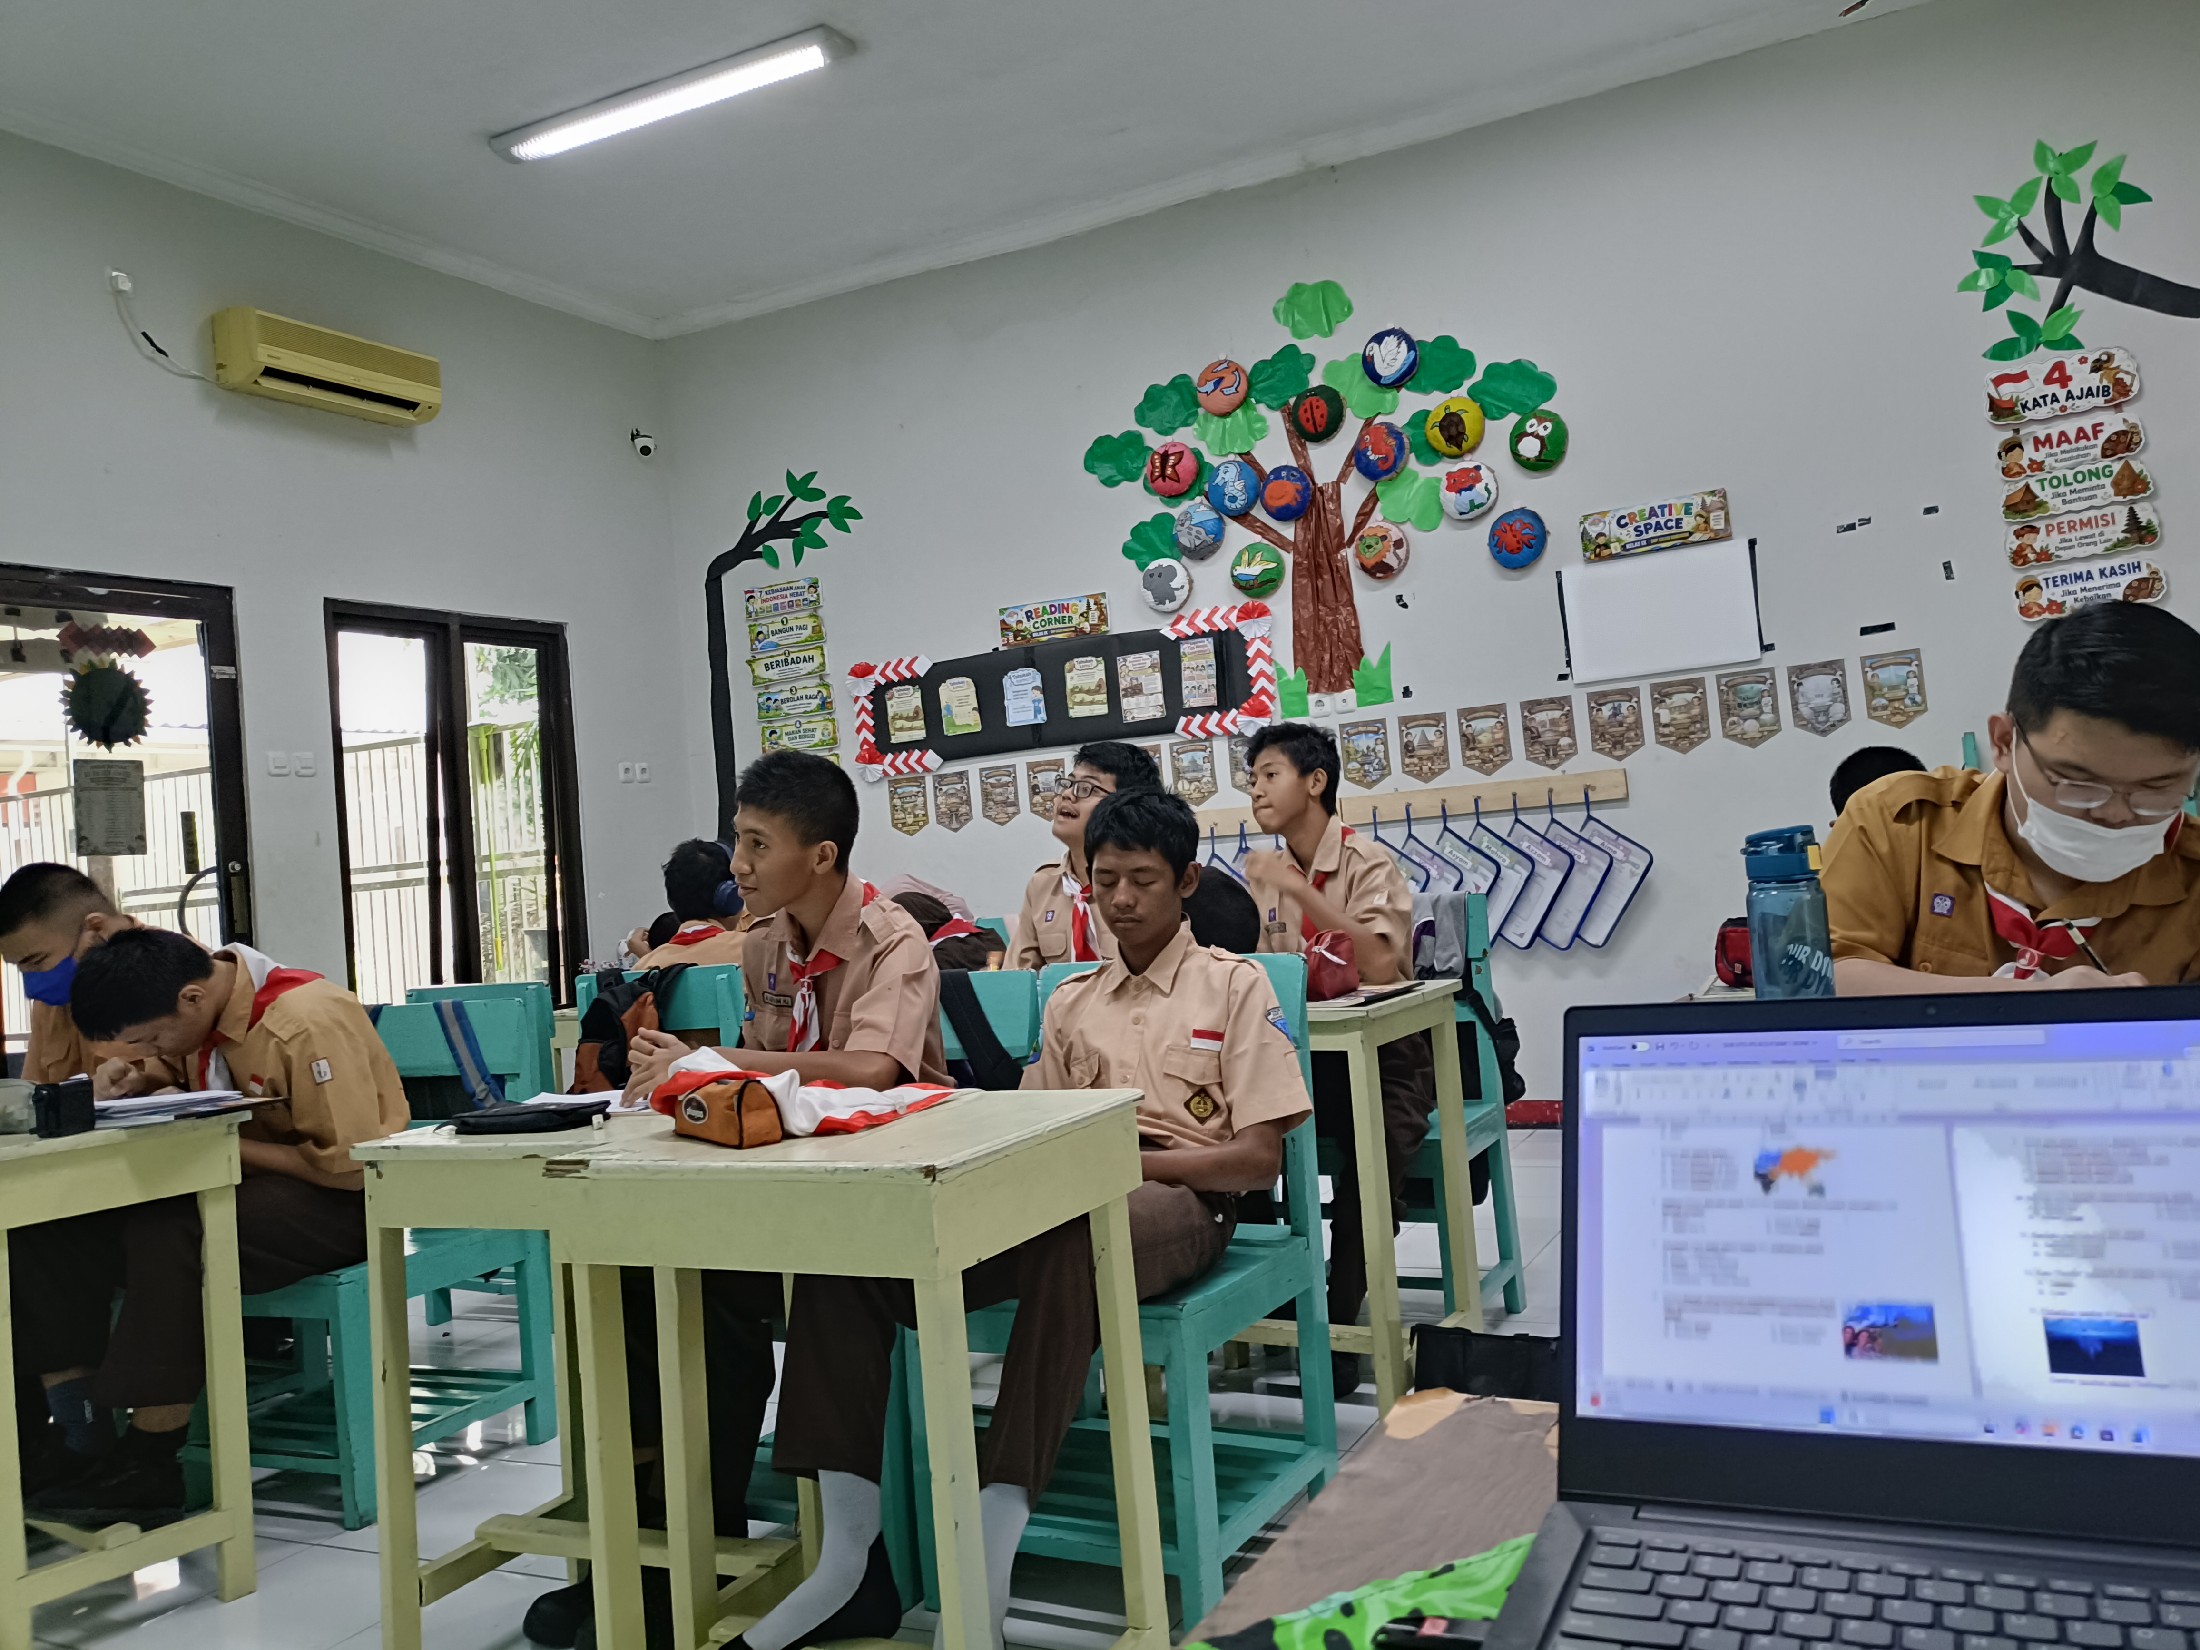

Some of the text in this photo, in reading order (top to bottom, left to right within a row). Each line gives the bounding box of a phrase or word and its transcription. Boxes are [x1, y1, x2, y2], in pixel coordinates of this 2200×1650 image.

[2043, 360, 2073, 389] 4
[2020, 384, 2111, 413] KATA AJAIB
[2032, 422, 2105, 452] MAAF
[2035, 464, 2114, 491] TOLONG
[2050, 483, 2106, 500] Jika Meminta
[2062, 494, 2097, 505] Bantuan
[1616, 502, 1694, 529] CREATIVE
[2044, 512, 2116, 537] PERMISI
[1633, 517, 1684, 537] SPACE
[2043, 561, 2142, 589] TERIMA KASIH
[761, 593, 788, 604] INDONESIA
[2061, 582, 2121, 597] Jika Menerima
[1025, 602, 1079, 622] READING
[771, 626, 794, 637] BANGUN
[1032, 615, 1074, 630] CORNER
[764, 655, 815, 672] BERIBADAH
[780, 694, 804, 705] BEROLAH
